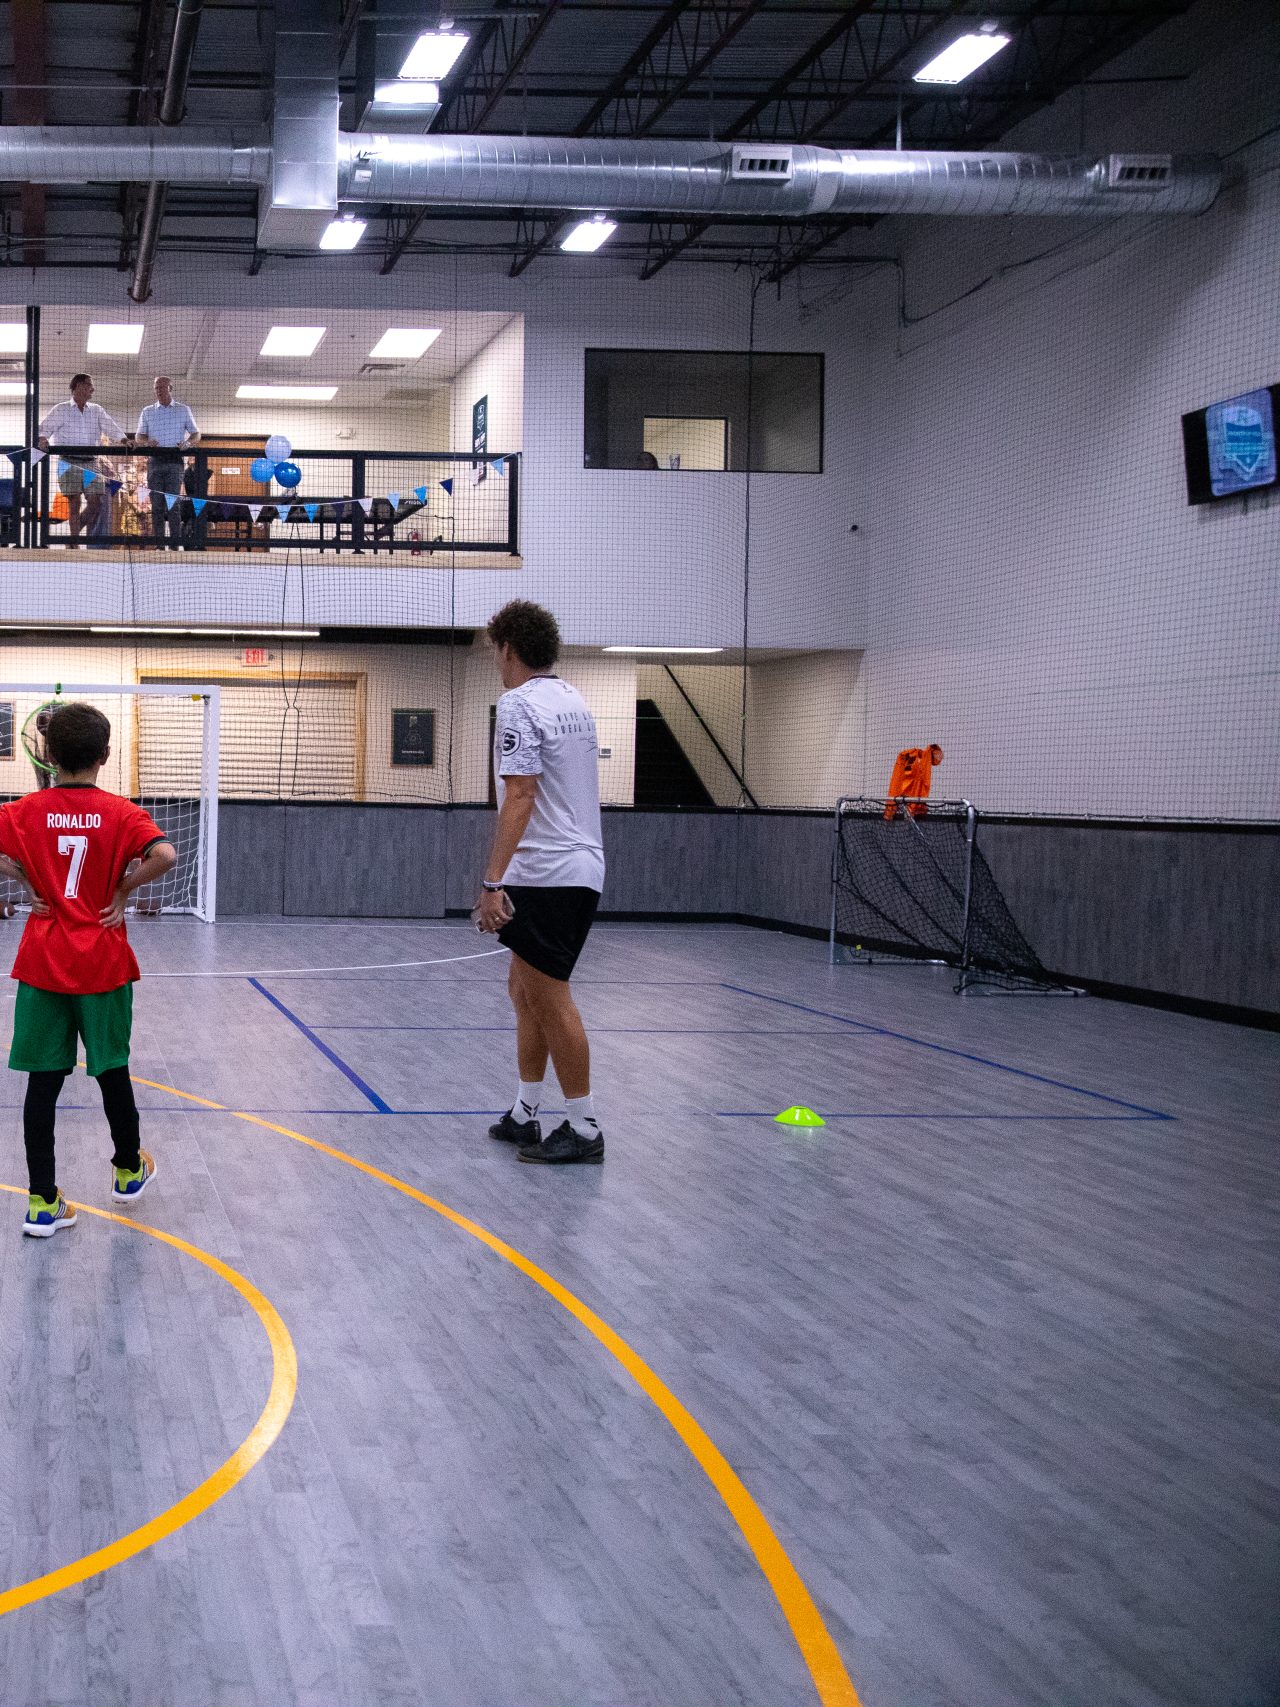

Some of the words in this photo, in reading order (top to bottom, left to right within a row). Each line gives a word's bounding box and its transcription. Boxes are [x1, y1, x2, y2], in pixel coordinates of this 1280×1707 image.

[245, 648, 265, 663] EXIT
[46, 813, 101, 829] RONALDO
[57, 836, 88, 899] 7
